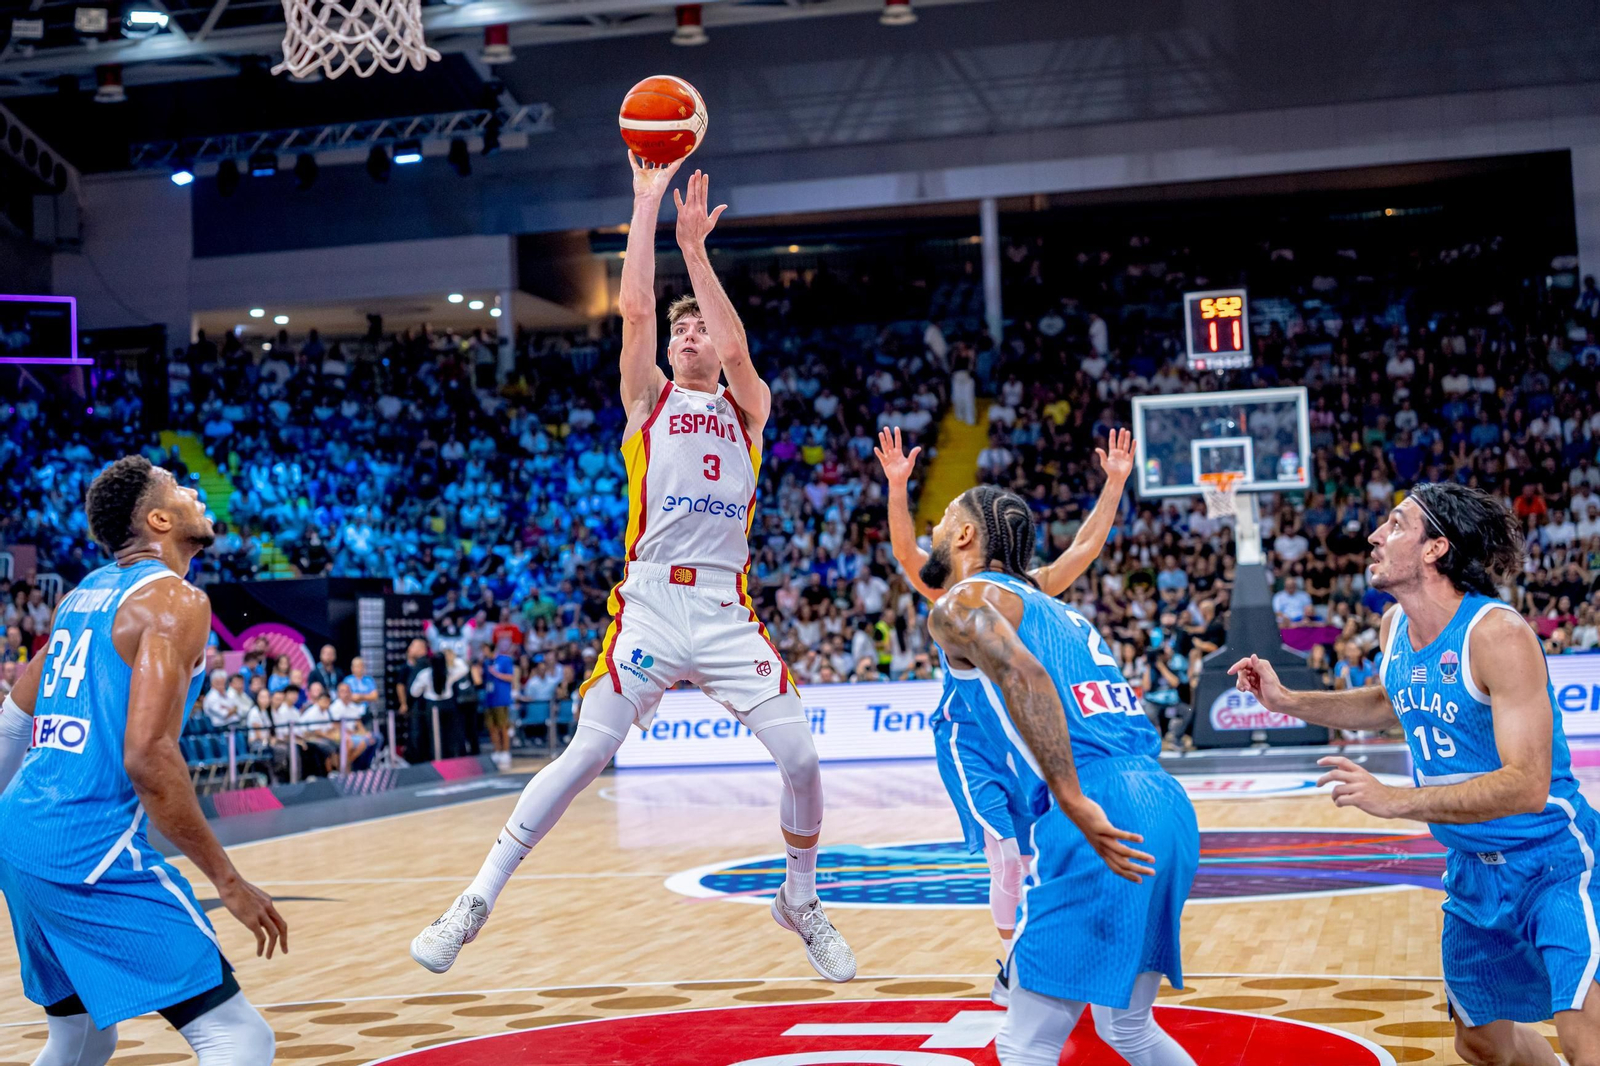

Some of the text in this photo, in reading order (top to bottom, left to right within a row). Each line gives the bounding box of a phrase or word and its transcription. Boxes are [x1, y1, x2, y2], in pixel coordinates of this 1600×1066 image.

[1200, 296, 1242, 319] 5:52
[1209, 320, 1241, 352] 11
[703, 453, 721, 481] 3
[662, 494, 747, 521] endesa
[1065, 609, 1118, 668] 2
[43, 629, 93, 698] 34
[1391, 687, 1459, 724] HELLAS
[1413, 726, 1457, 761] 19
